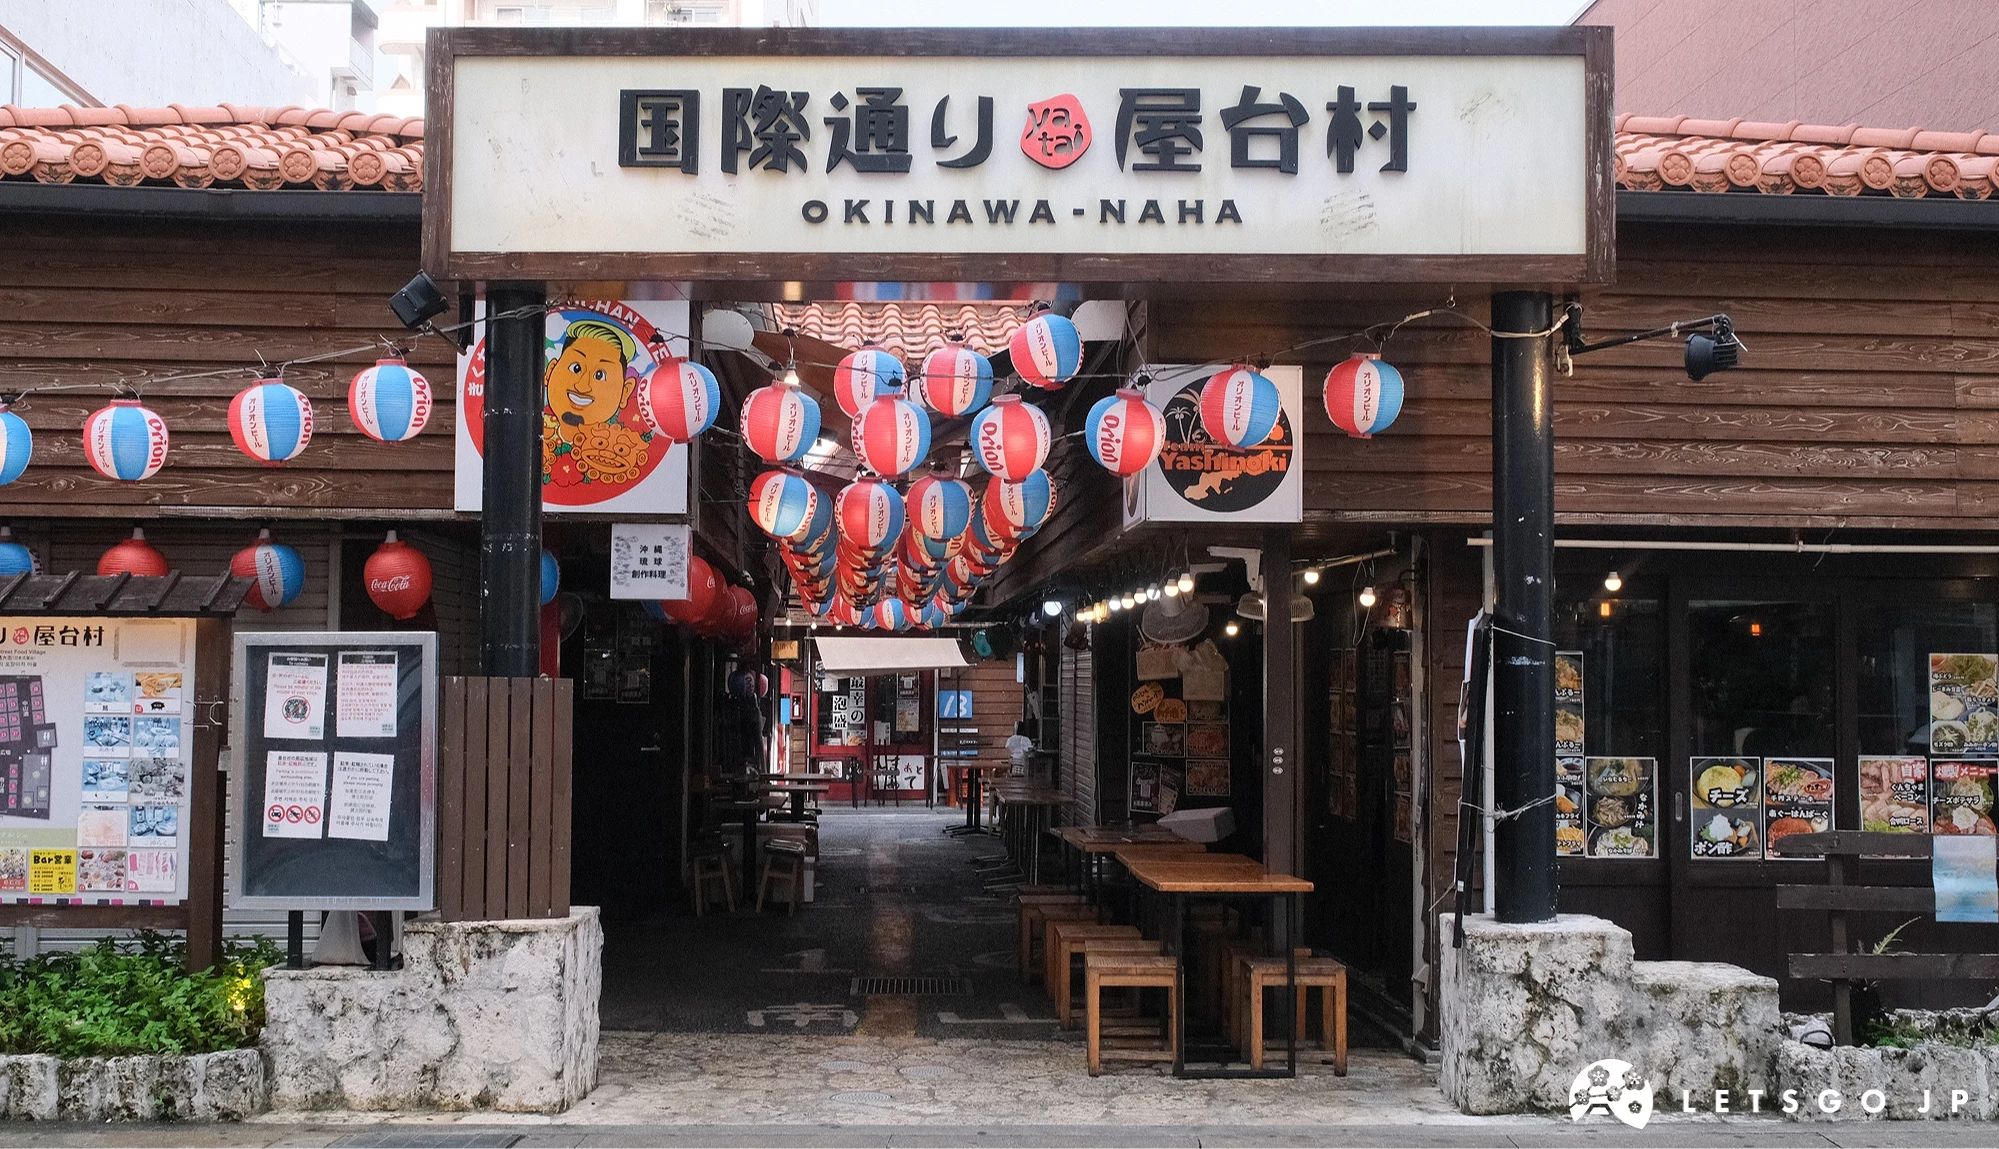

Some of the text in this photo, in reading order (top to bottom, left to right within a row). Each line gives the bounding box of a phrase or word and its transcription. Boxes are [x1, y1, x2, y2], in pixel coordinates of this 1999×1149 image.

[618, 84, 994, 175] 国際通り
[1115, 84, 1416, 174] 屋台村
[802, 199, 1243, 226] OKINAWA-NAHA
[411, 376, 429, 428] Orion
[639, 378, 656, 429] Orion
[687, 371, 702, 423] オリオンビール
[1231, 380, 1244, 432] オリオンビール
[1361, 371, 1371, 422] オリオンビール
[297, 393, 313, 445] Orion
[783, 402, 797, 451] オリオンビール
[903, 412, 912, 463] オリオンビール
[1101, 414, 1121, 463] Orion
[148, 417, 167, 469] Orion
[982, 421, 1004, 471] Orion
[1160, 450, 1287, 471] Yashinoki
[764, 482, 780, 523] オリオンビール
[875, 494, 885, 538] オリオンビール
[930, 494, 940, 535] オリオンビール
[263, 551, 278, 595] オリオンビール
[371, 575, 410, 592] Coca-Cola
[632, 570, 666, 579] 創作料理
[34, 625, 104, 646] 屋台村
[834, 697, 847, 728] 泡盛
[1900, 763, 1926, 779] 自家
[1936, 764, 1997, 779] 燻製メニュー
[1634, 793, 1649, 829] なかみ汁
[1709, 788, 1750, 804] チーズ
[33, 854, 72, 865] Bar営業
[1694, 841, 1733, 855] ポン酢
